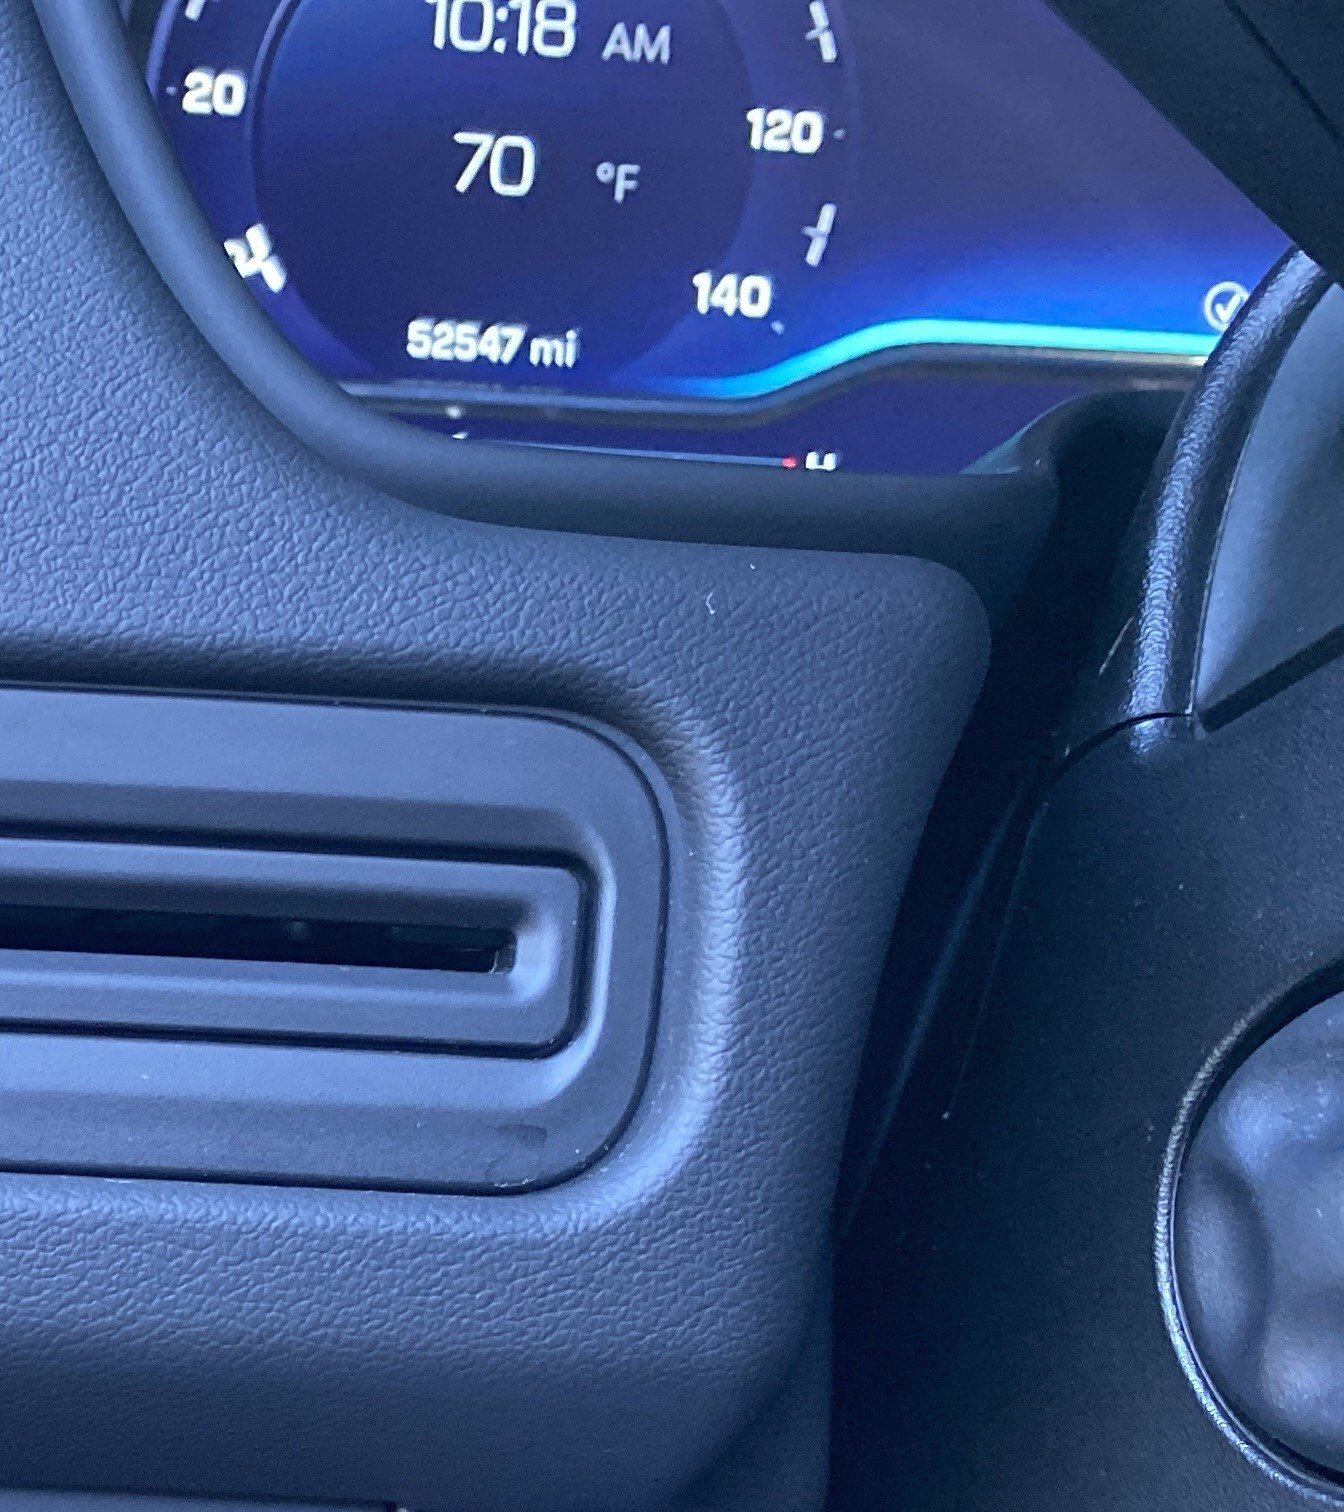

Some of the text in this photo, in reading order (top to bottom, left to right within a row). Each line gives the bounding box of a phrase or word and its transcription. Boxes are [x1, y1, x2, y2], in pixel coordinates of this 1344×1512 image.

[425, 0, 671, 65] 10:18 AM
[182, 69, 246, 116] 20
[746, 108, 824, 154] 120
[453, 131, 536, 197] 70
[693, 271, 772, 318] 140
[407, 319, 578, 368] 52547 mi
